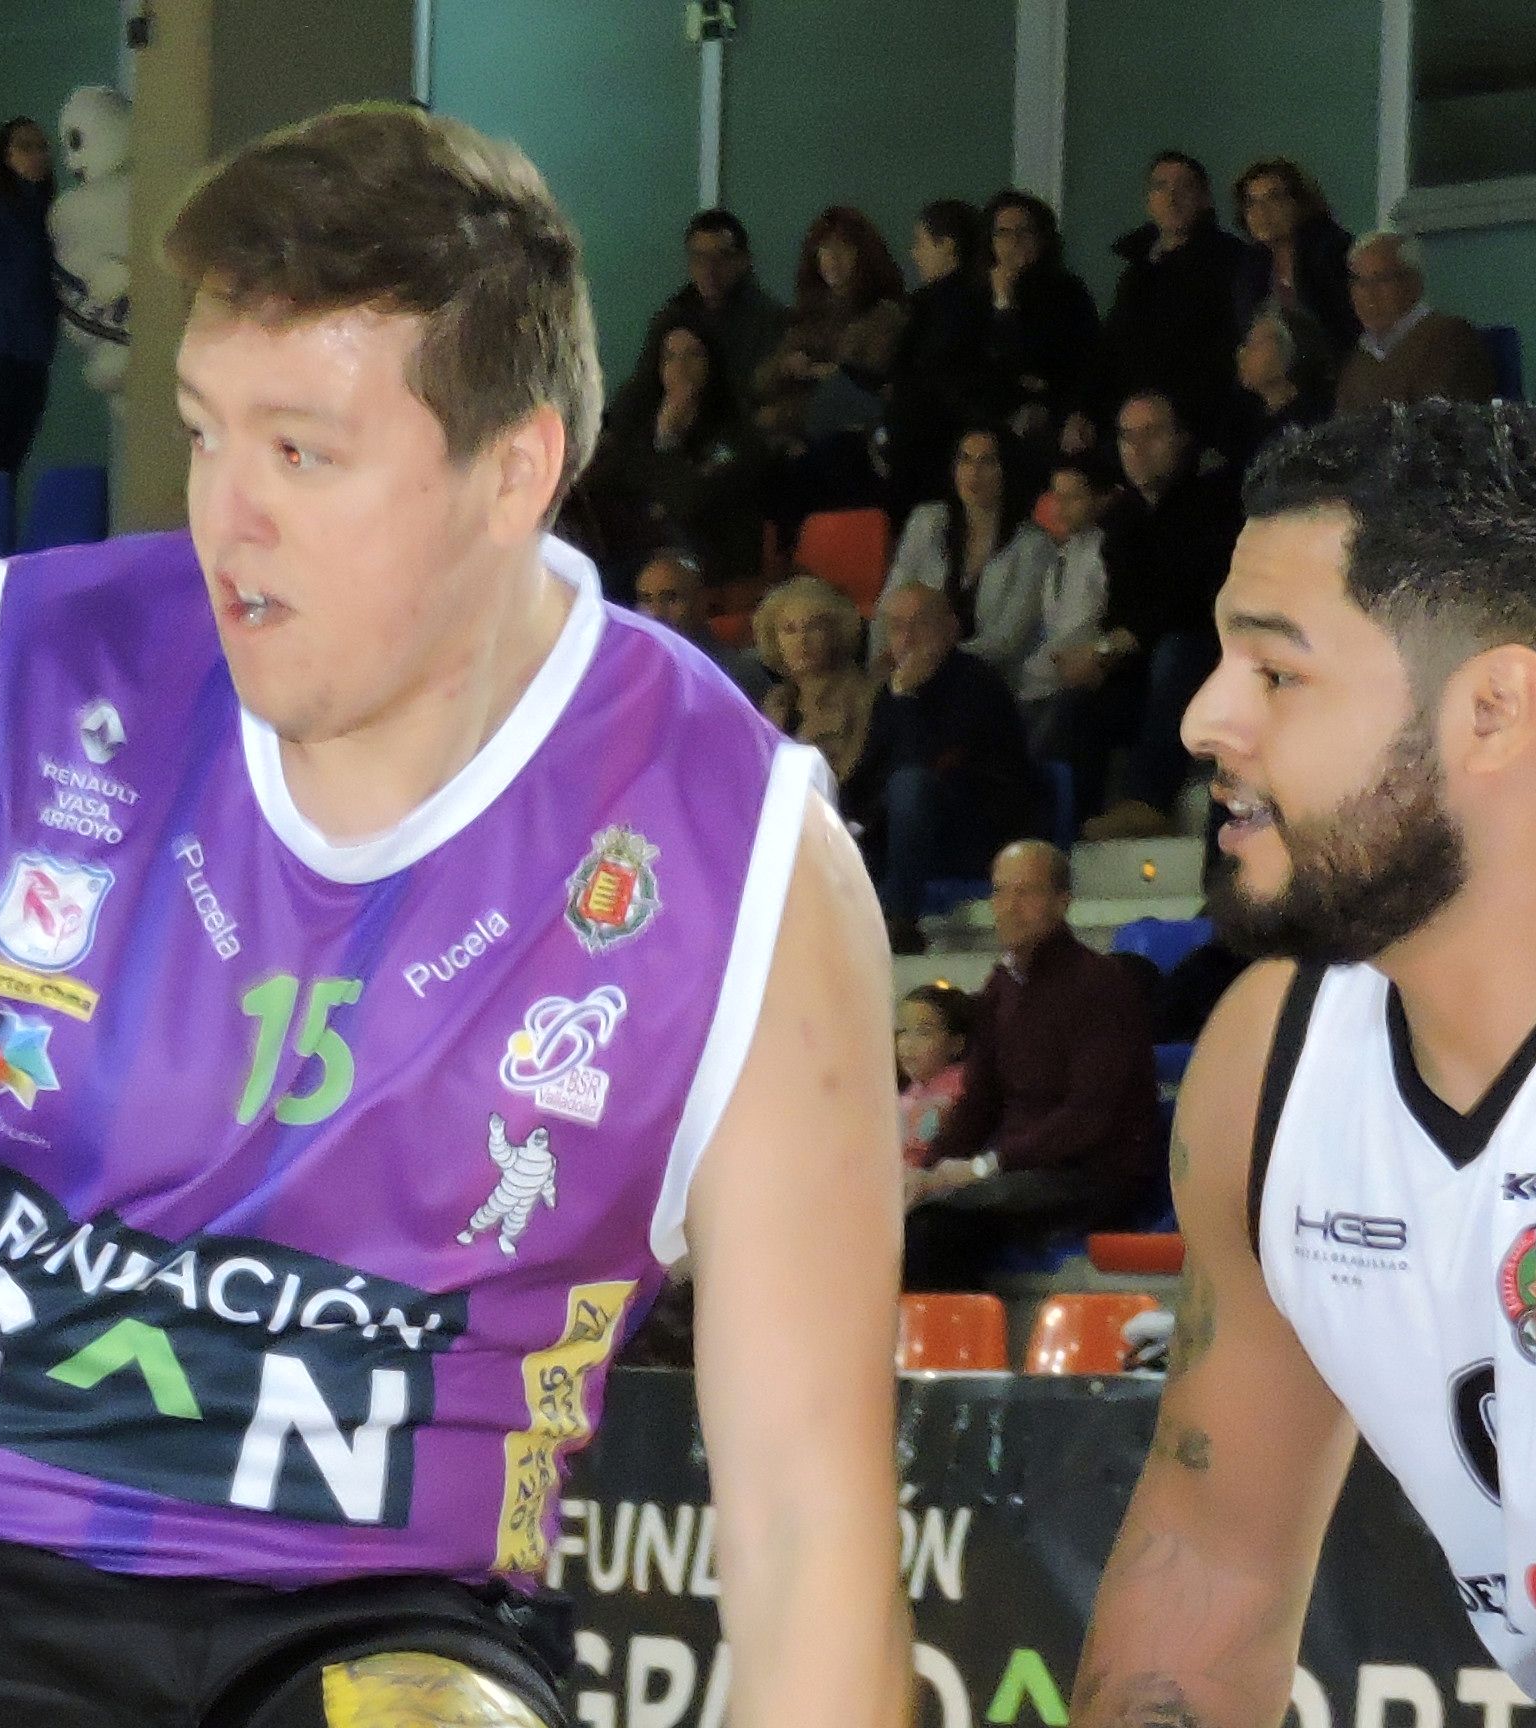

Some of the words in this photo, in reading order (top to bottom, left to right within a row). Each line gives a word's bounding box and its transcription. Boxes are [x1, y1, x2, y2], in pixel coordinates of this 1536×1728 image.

[40, 762, 142, 806] RENAULT
[175, 840, 242, 962] Pucela
[403, 909, 510, 999] Pucela
[234, 974, 363, 1126] 15
